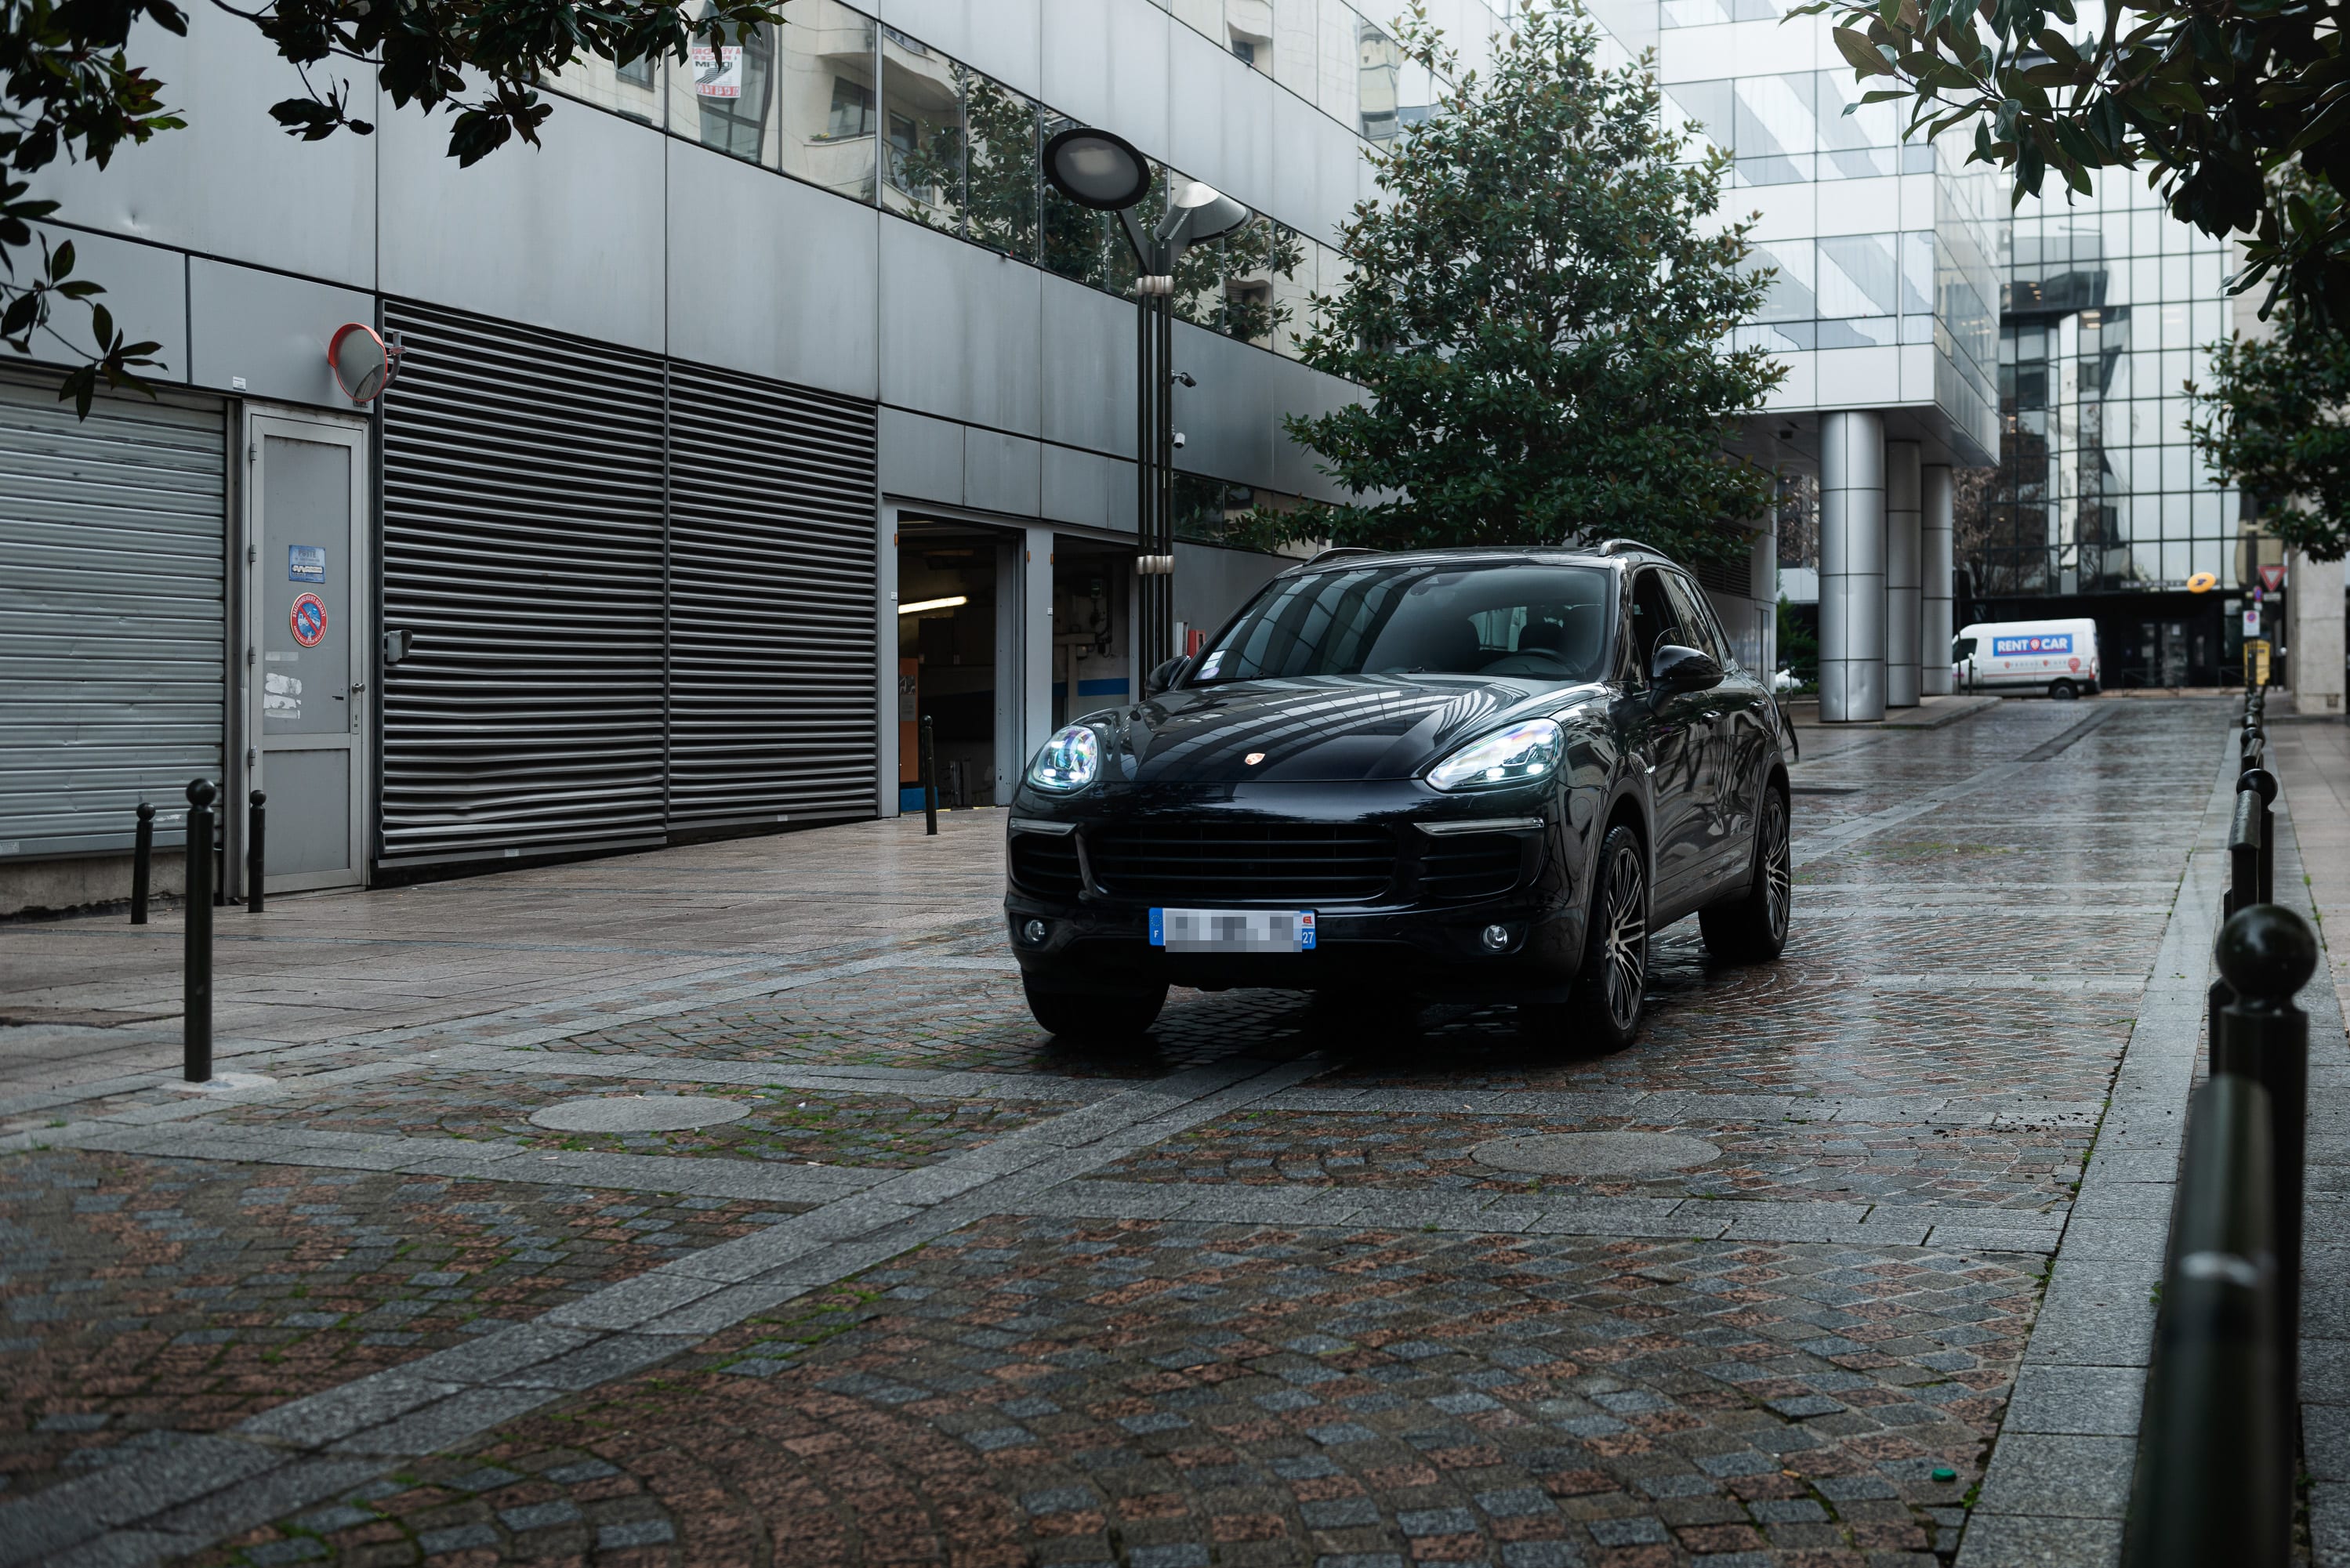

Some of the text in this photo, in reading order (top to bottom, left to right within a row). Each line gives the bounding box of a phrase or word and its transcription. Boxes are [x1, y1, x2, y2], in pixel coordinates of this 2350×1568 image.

[1997, 639, 2029, 652] RENT
[2041, 637, 2068, 650] CAR
[1302, 932, 1314, 944] 27
